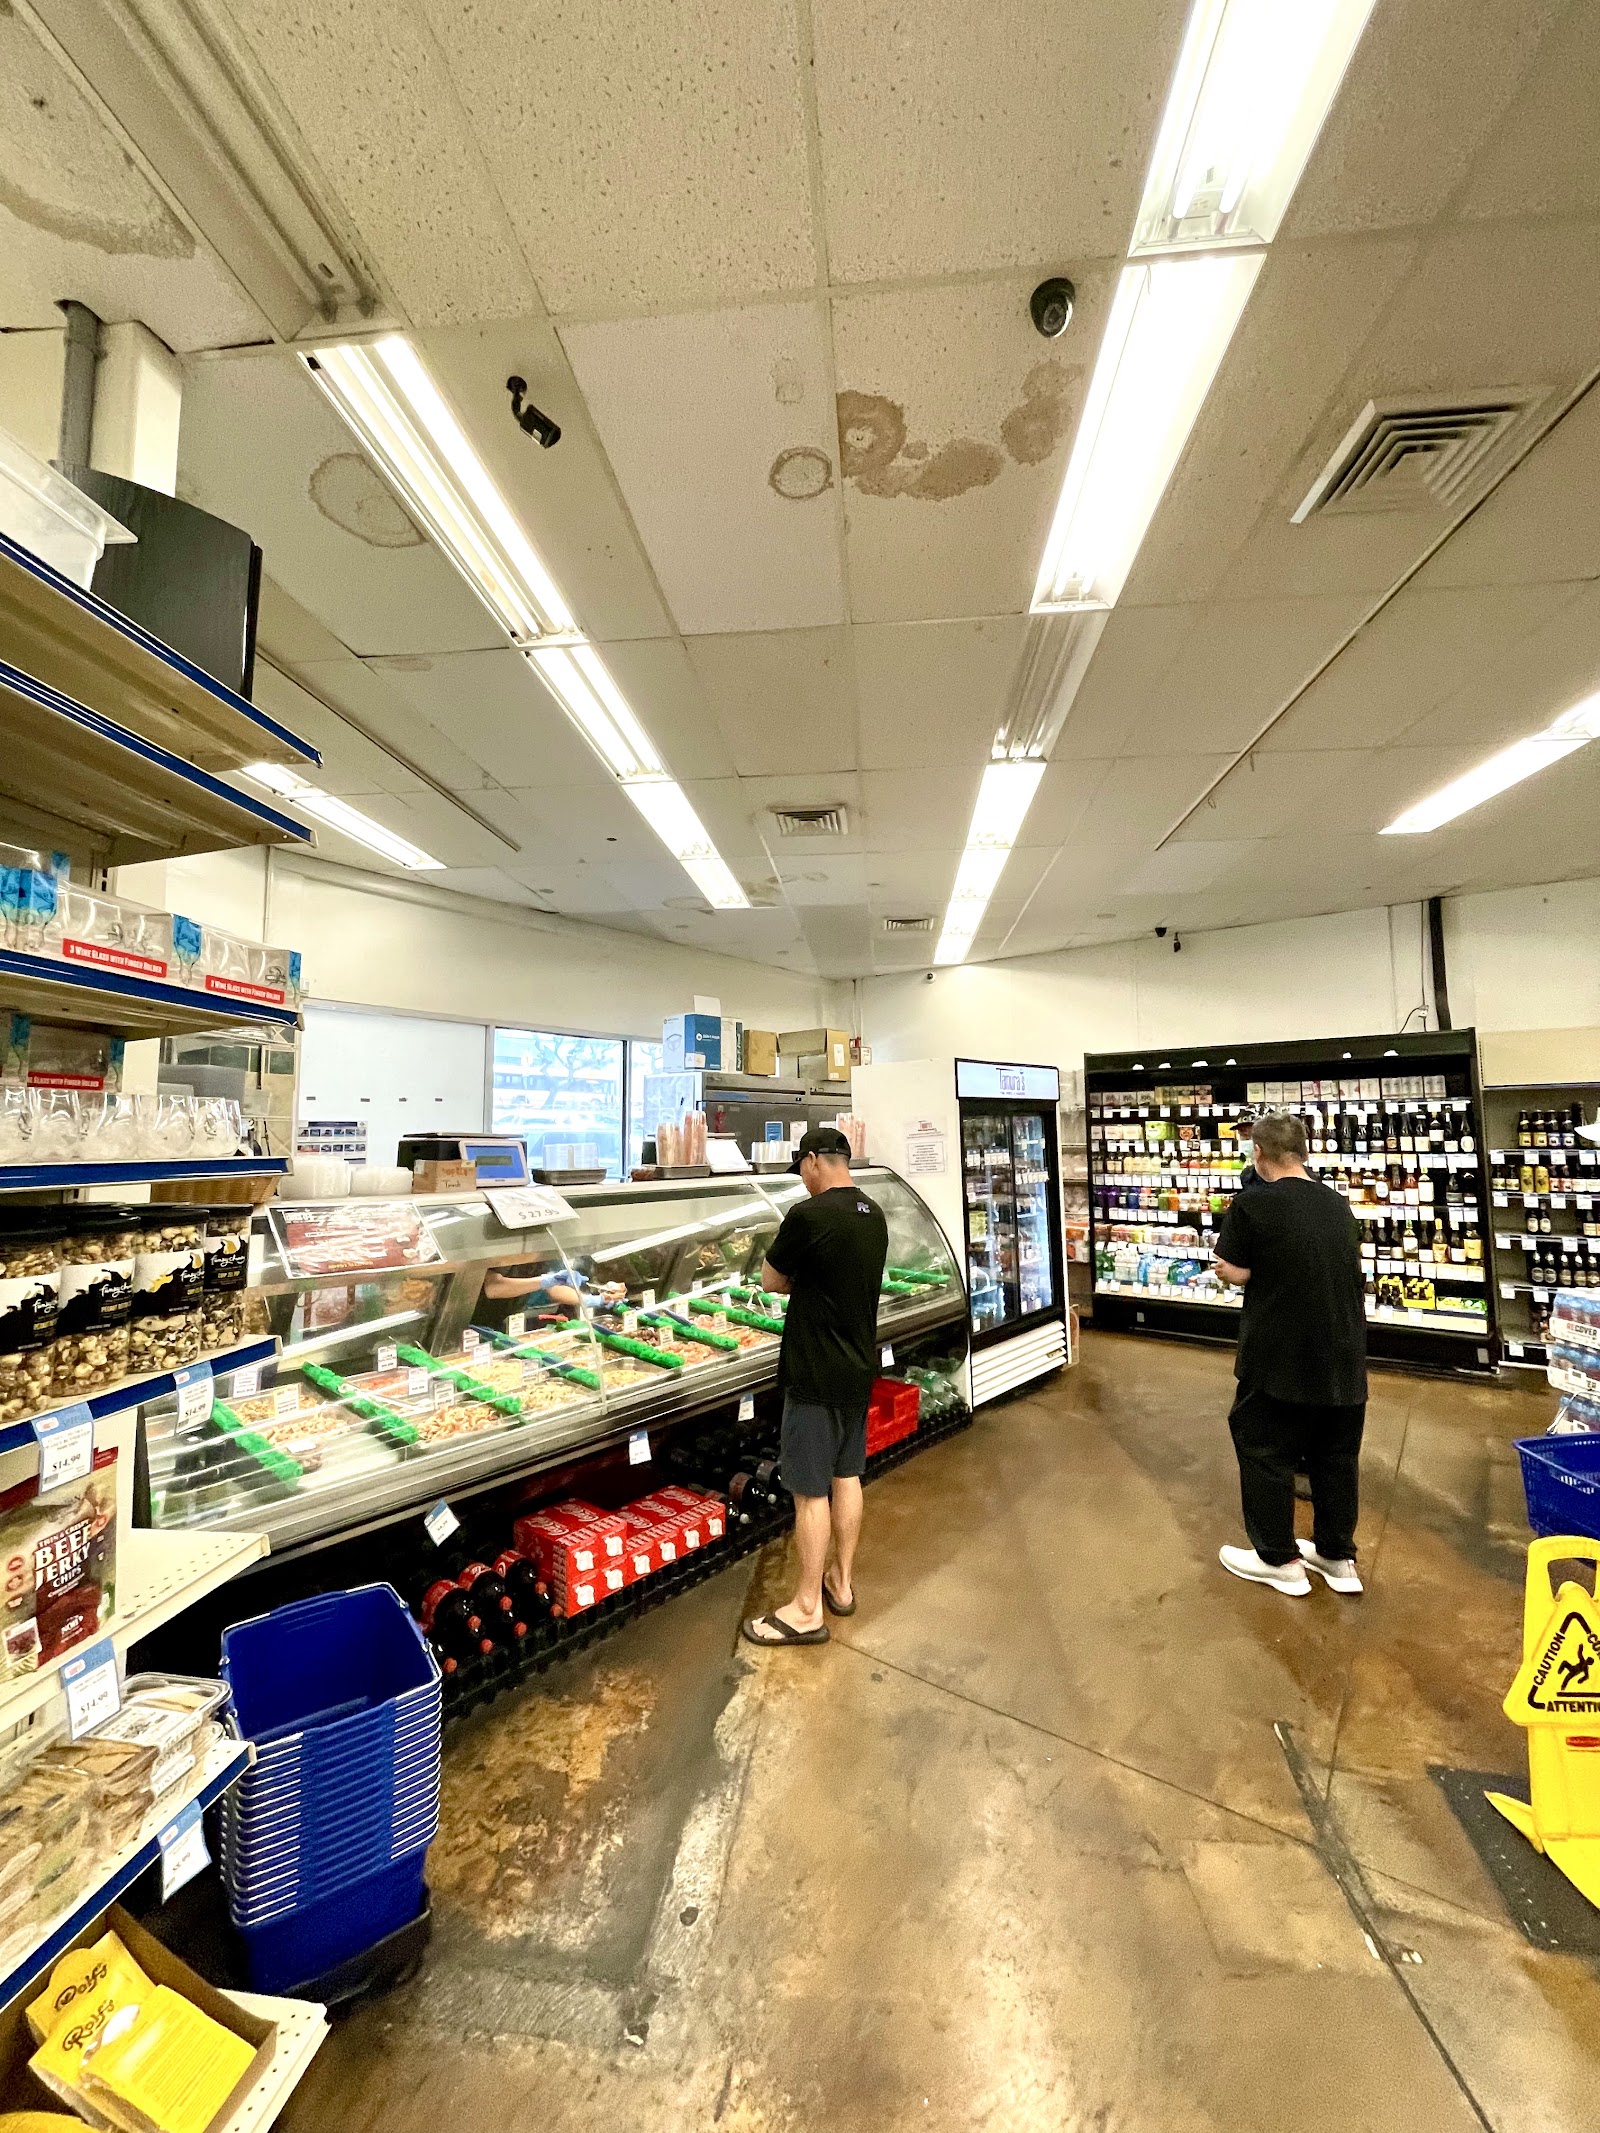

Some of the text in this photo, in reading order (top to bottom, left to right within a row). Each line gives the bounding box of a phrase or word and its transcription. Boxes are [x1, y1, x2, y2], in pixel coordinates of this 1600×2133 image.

[1566, 1322, 1598, 1336] RECOVER
[52, 1453, 81, 1472] $14.99
[34, 1524, 92, 1571] BEEF
[34, 1542, 92, 1591] JERKY
[52, 1564, 83, 1588] CHIPS
[1533, 1632, 1566, 1686] CAUTION
[80, 1690, 108, 1715] $14.99
[1547, 1700, 1600, 1713] ATTENTI
